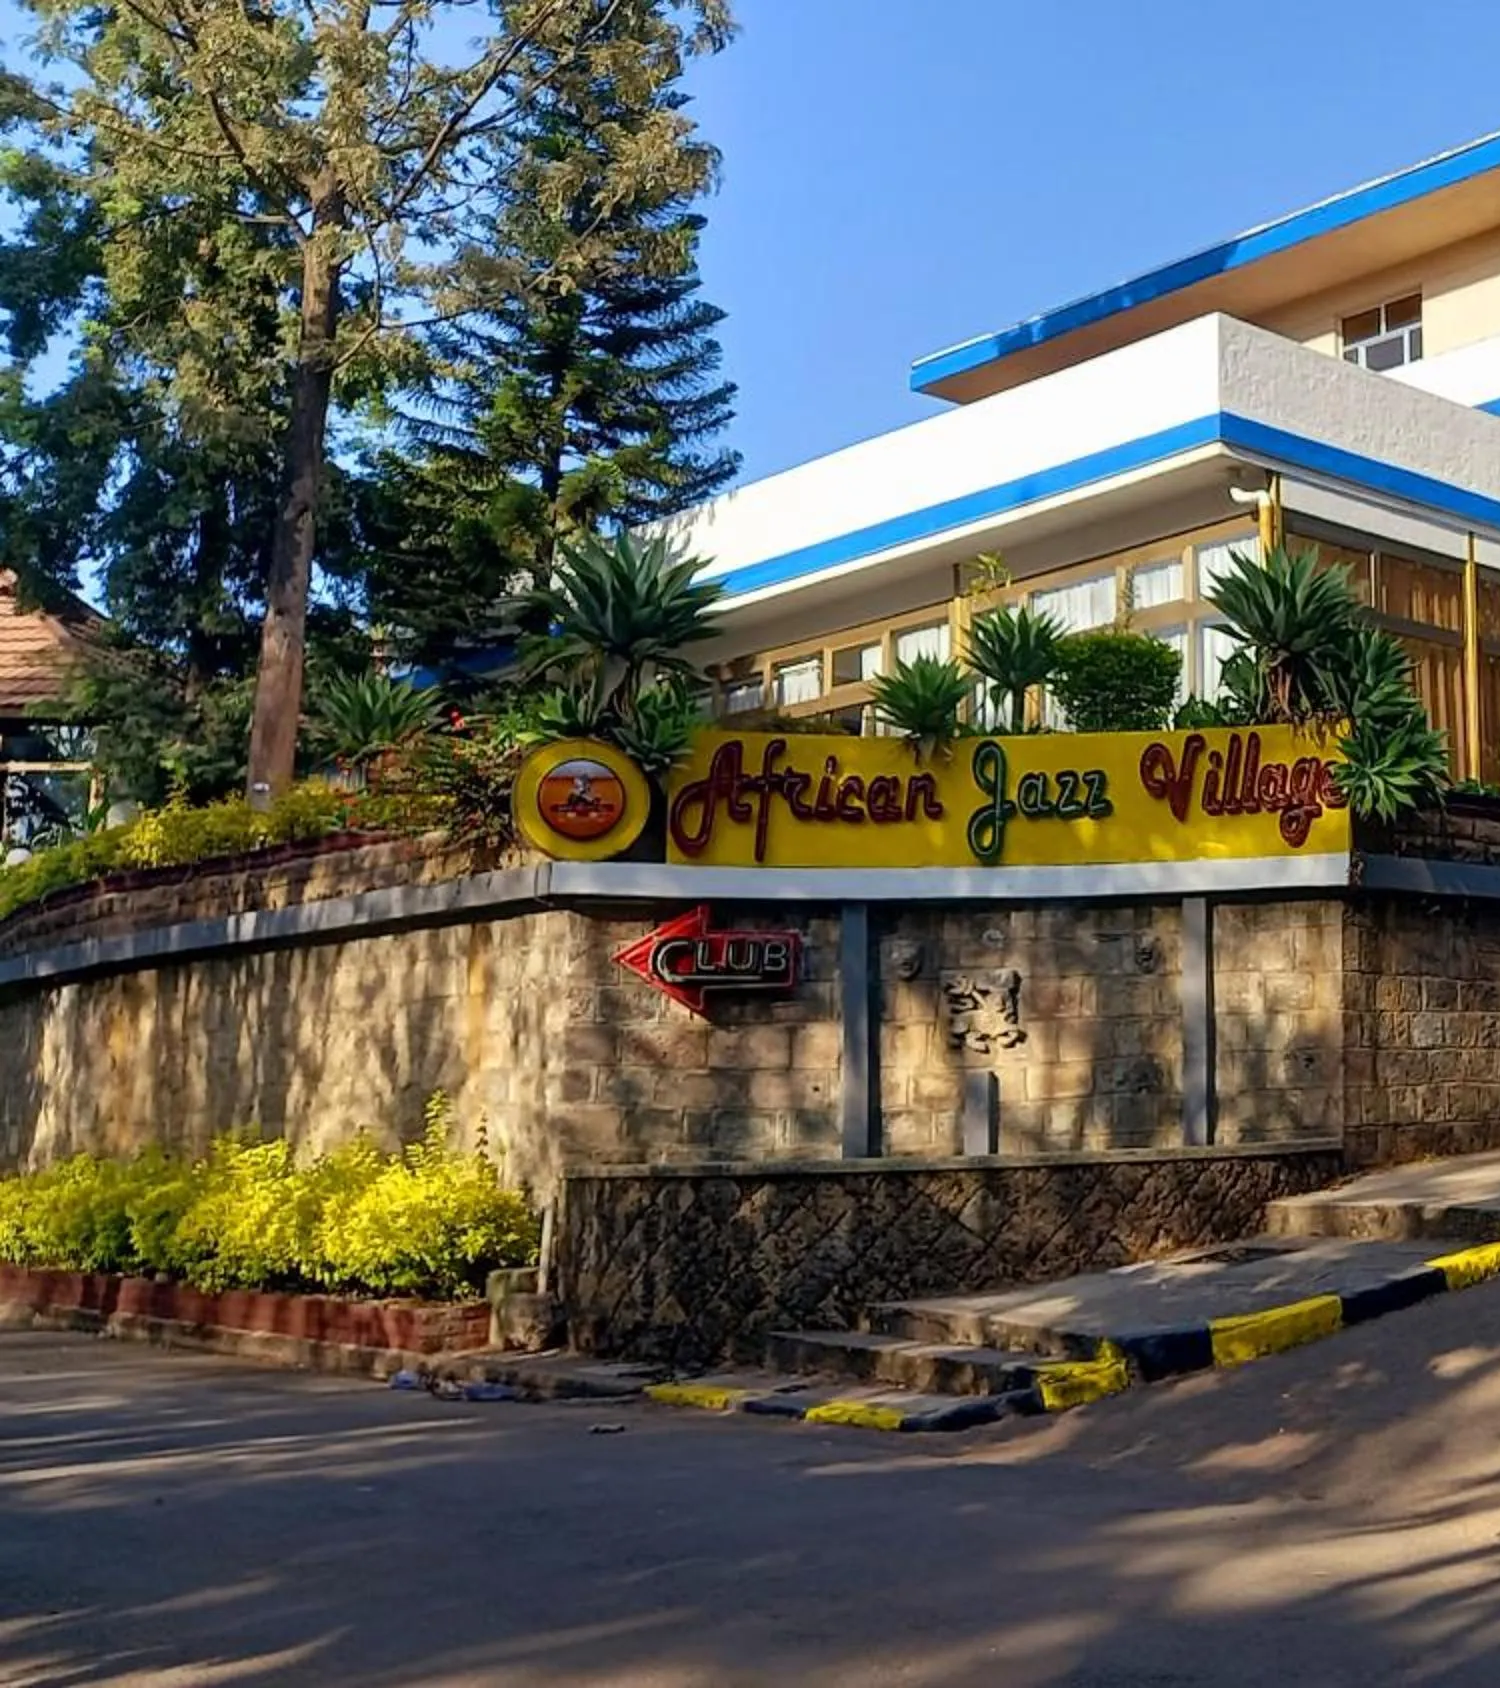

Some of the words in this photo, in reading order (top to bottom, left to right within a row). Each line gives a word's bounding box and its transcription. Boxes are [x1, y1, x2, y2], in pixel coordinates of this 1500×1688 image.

[670, 739, 944, 863] African
[968, 739, 1114, 865] Jazz
[1140, 731, 1349, 848] Village
[652, 938, 789, 984] CLUB
